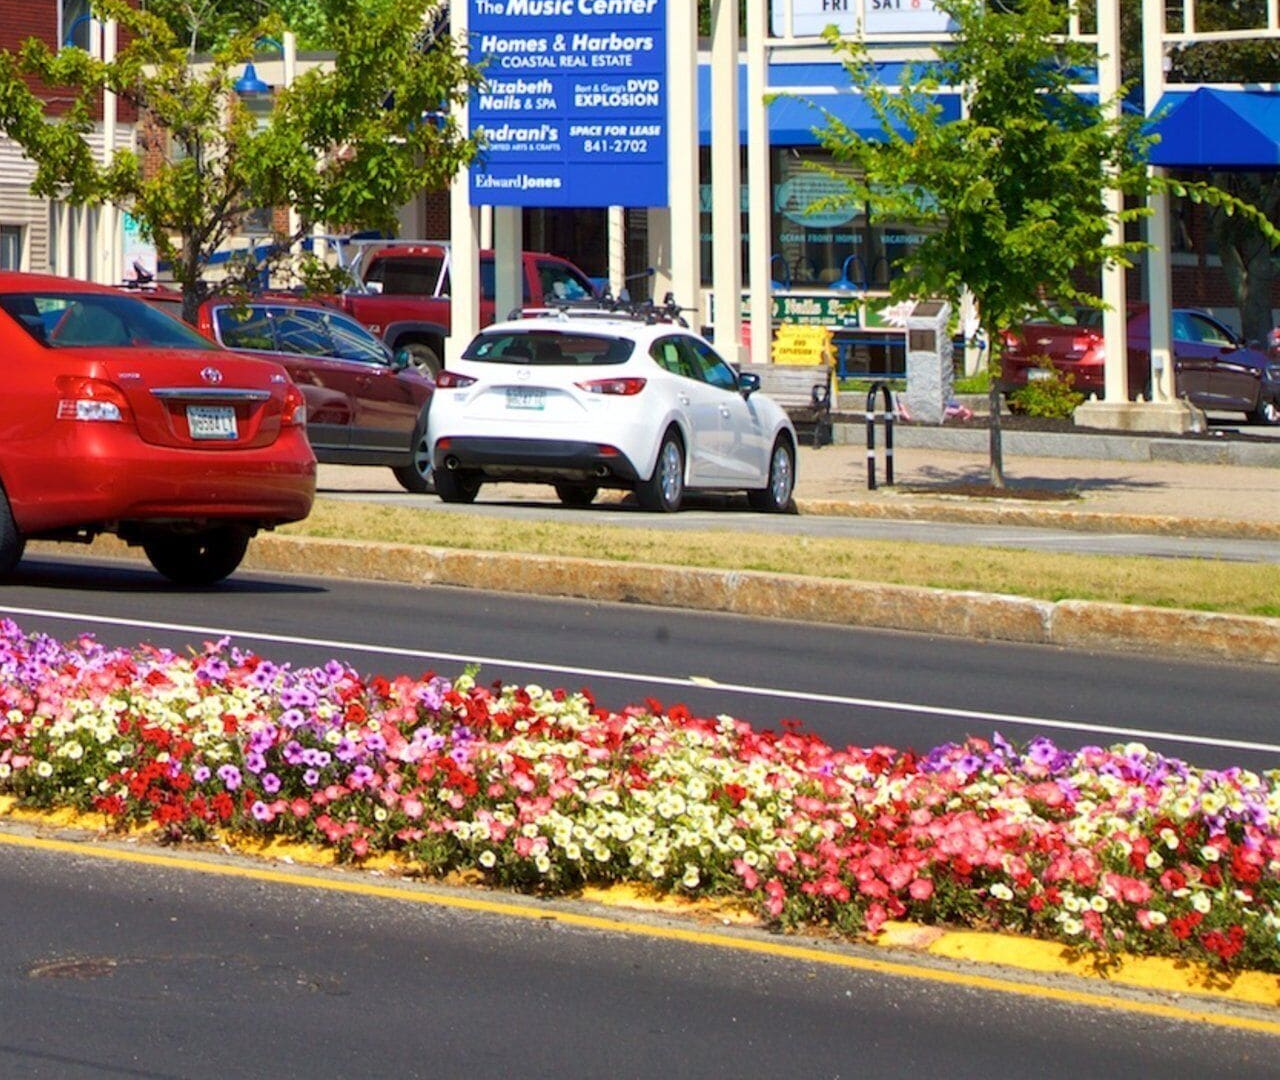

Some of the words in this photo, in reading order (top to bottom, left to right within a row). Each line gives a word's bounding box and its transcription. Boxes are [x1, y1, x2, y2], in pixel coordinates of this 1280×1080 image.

[476, 0, 503, 15] The
[481, 35, 547, 52] Homes
[552, 34, 566, 52] &
[572, 33, 653, 52] Harbors
[501, 55, 556, 68] COASTAL
[559, 55, 588, 67] REAL
[592, 54, 632, 67] ESTATE
[627, 79, 659, 92] DVD
[479, 95, 521, 110] Nails
[524, 99, 533, 110] &
[535, 98, 557, 110] SPA
[574, 93, 659, 107] EXPLOSION
[569, 126, 602, 136] SPACE
[604, 126, 627, 136] FOR
[629, 126, 661, 136] LEASE
[584, 140, 647, 152] 841-2702
